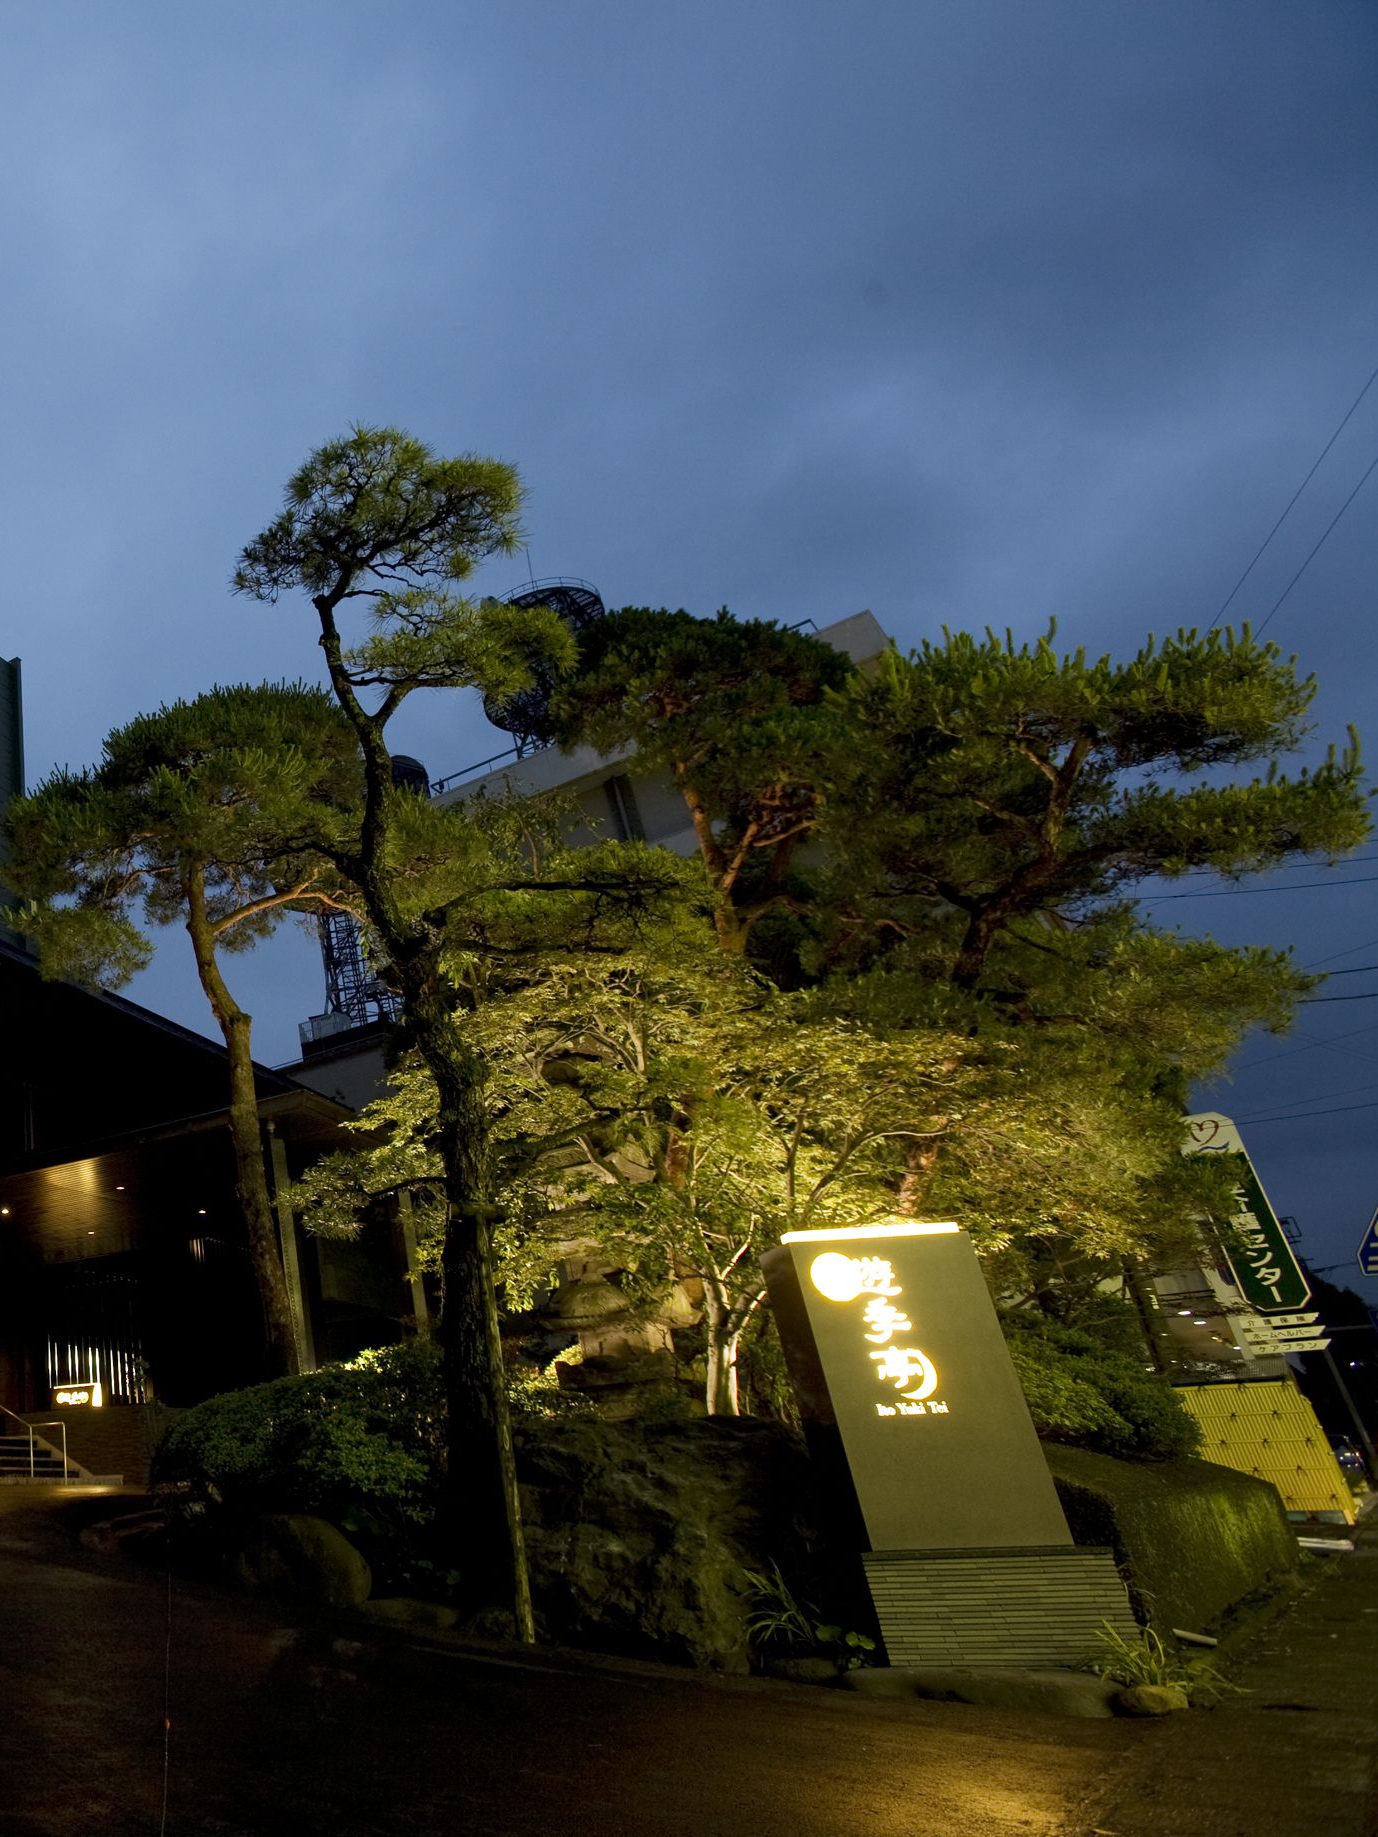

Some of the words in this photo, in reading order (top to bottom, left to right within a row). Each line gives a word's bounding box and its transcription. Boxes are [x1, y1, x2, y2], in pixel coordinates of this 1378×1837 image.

[1253, 1329, 1311, 1340] ホームヘルパー
[894, 1402, 927, 1416] Yuki
[926, 1400, 950, 1414] Tei
